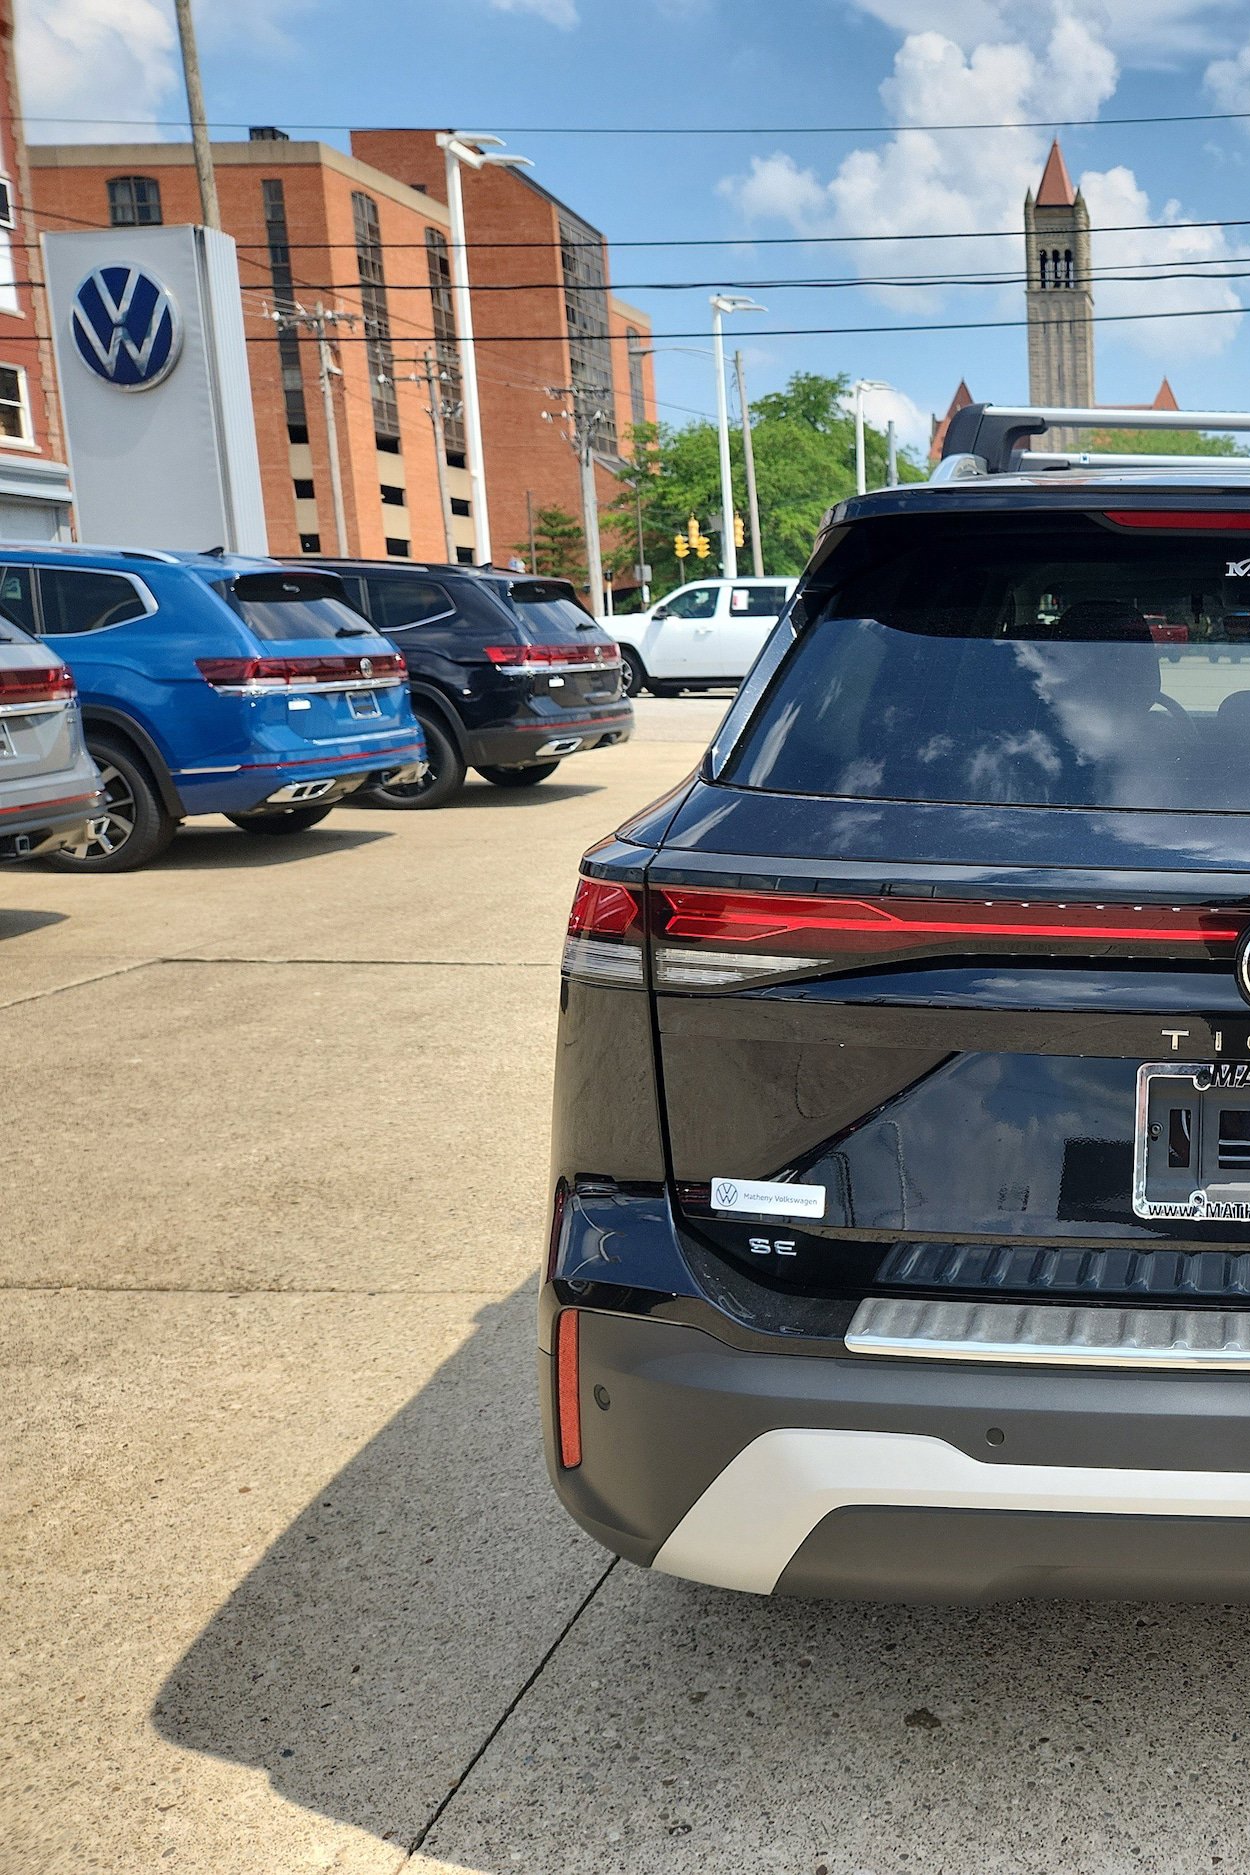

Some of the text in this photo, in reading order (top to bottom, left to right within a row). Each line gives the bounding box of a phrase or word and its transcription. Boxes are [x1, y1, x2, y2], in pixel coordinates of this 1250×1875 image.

[71, 264, 174, 384] VW
[743, 1192, 818, 1206] Matheny Volkswagen
[749, 1237, 797, 1256] SE
